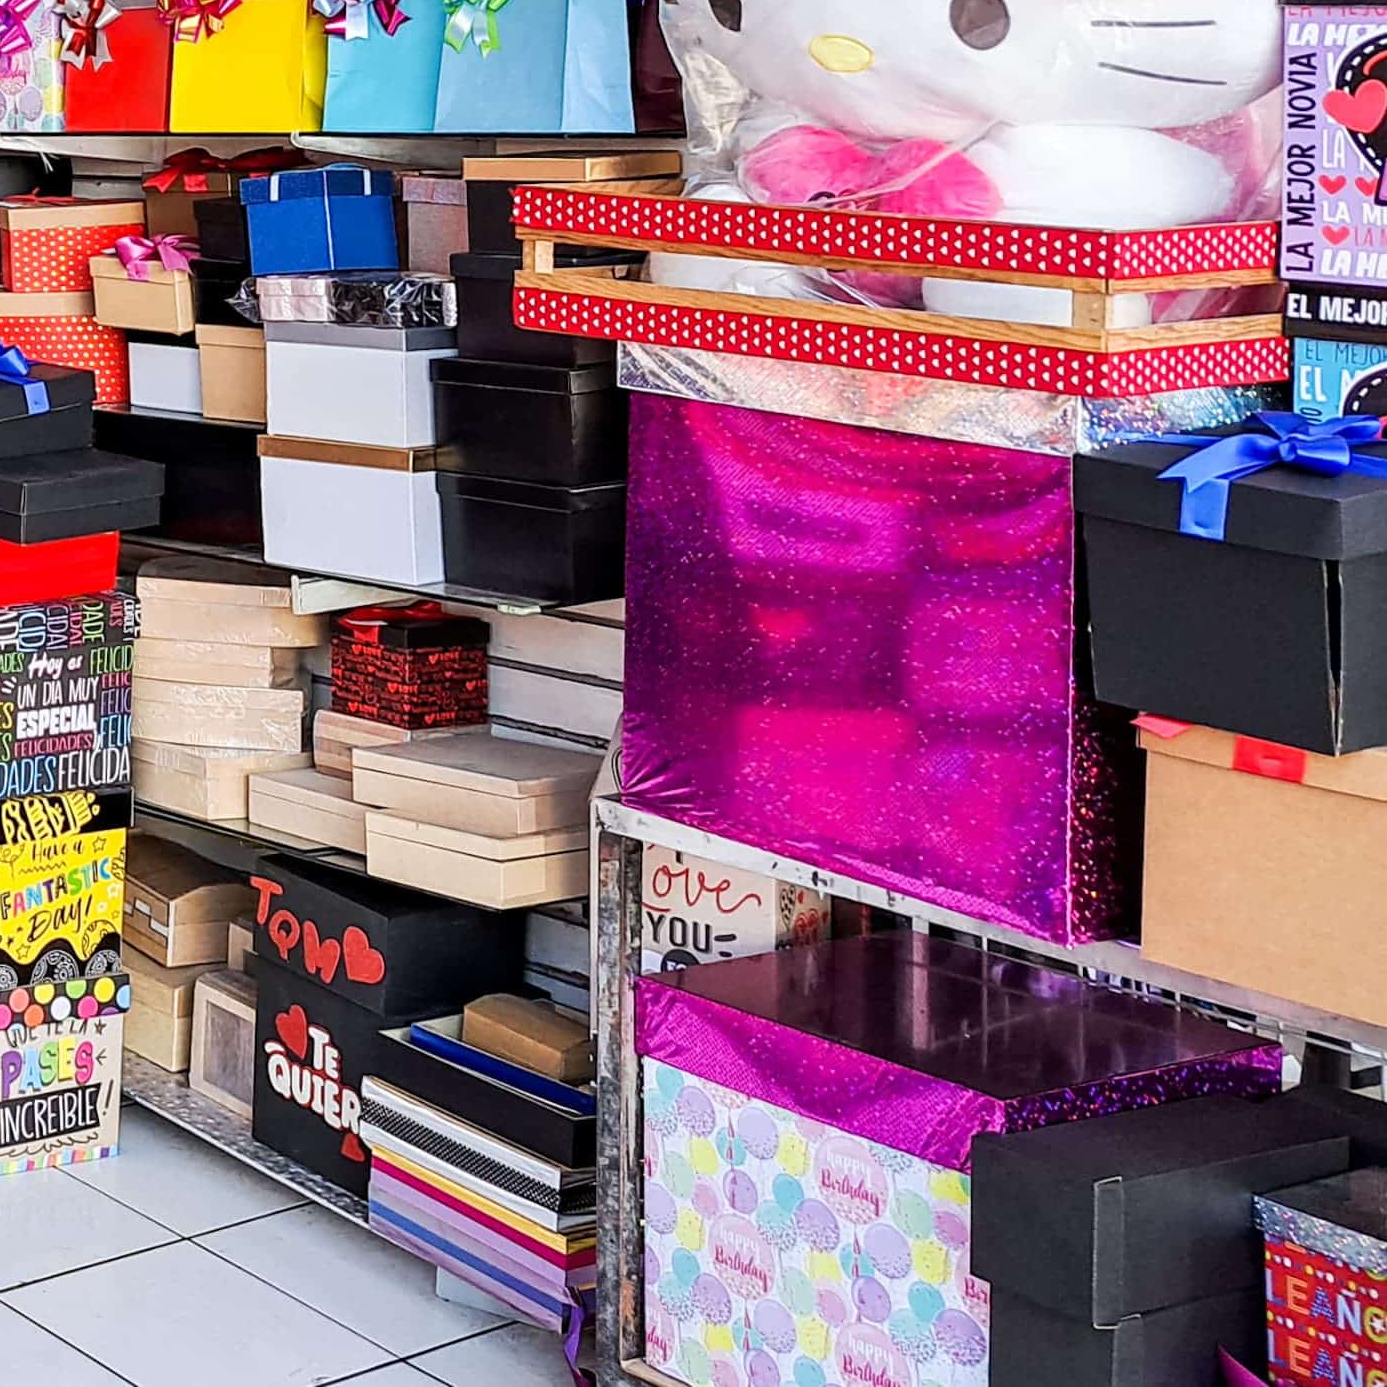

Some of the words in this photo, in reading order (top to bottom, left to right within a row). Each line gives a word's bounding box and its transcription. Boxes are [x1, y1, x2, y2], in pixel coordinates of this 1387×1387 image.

[1286, 51, 1318, 131] NOVIA
[1286, 143, 1316, 228] MEJOR
[1287, 292, 1313, 320] EL
[28, 652, 65, 680] Hoy
[16, 683, 37, 710] UN
[68, 675, 101, 705] MUY
[15, 702, 98, 740] ESPECIAL
[57, 746, 132, 792] FELICIDA
[0, 856, 113, 921] FANTASTIC
[645, 863, 763, 914] ove
[248, 875, 342, 985] TQM
[646, 910, 713, 954] YOU
[0, 1036, 95, 1103] PASES
[305, 1024, 341, 1080] TE
[264, 1049, 363, 1136] QUIER
[820, 1168, 880, 1217] Birthday
[714, 1243, 769, 1294] Birthday
